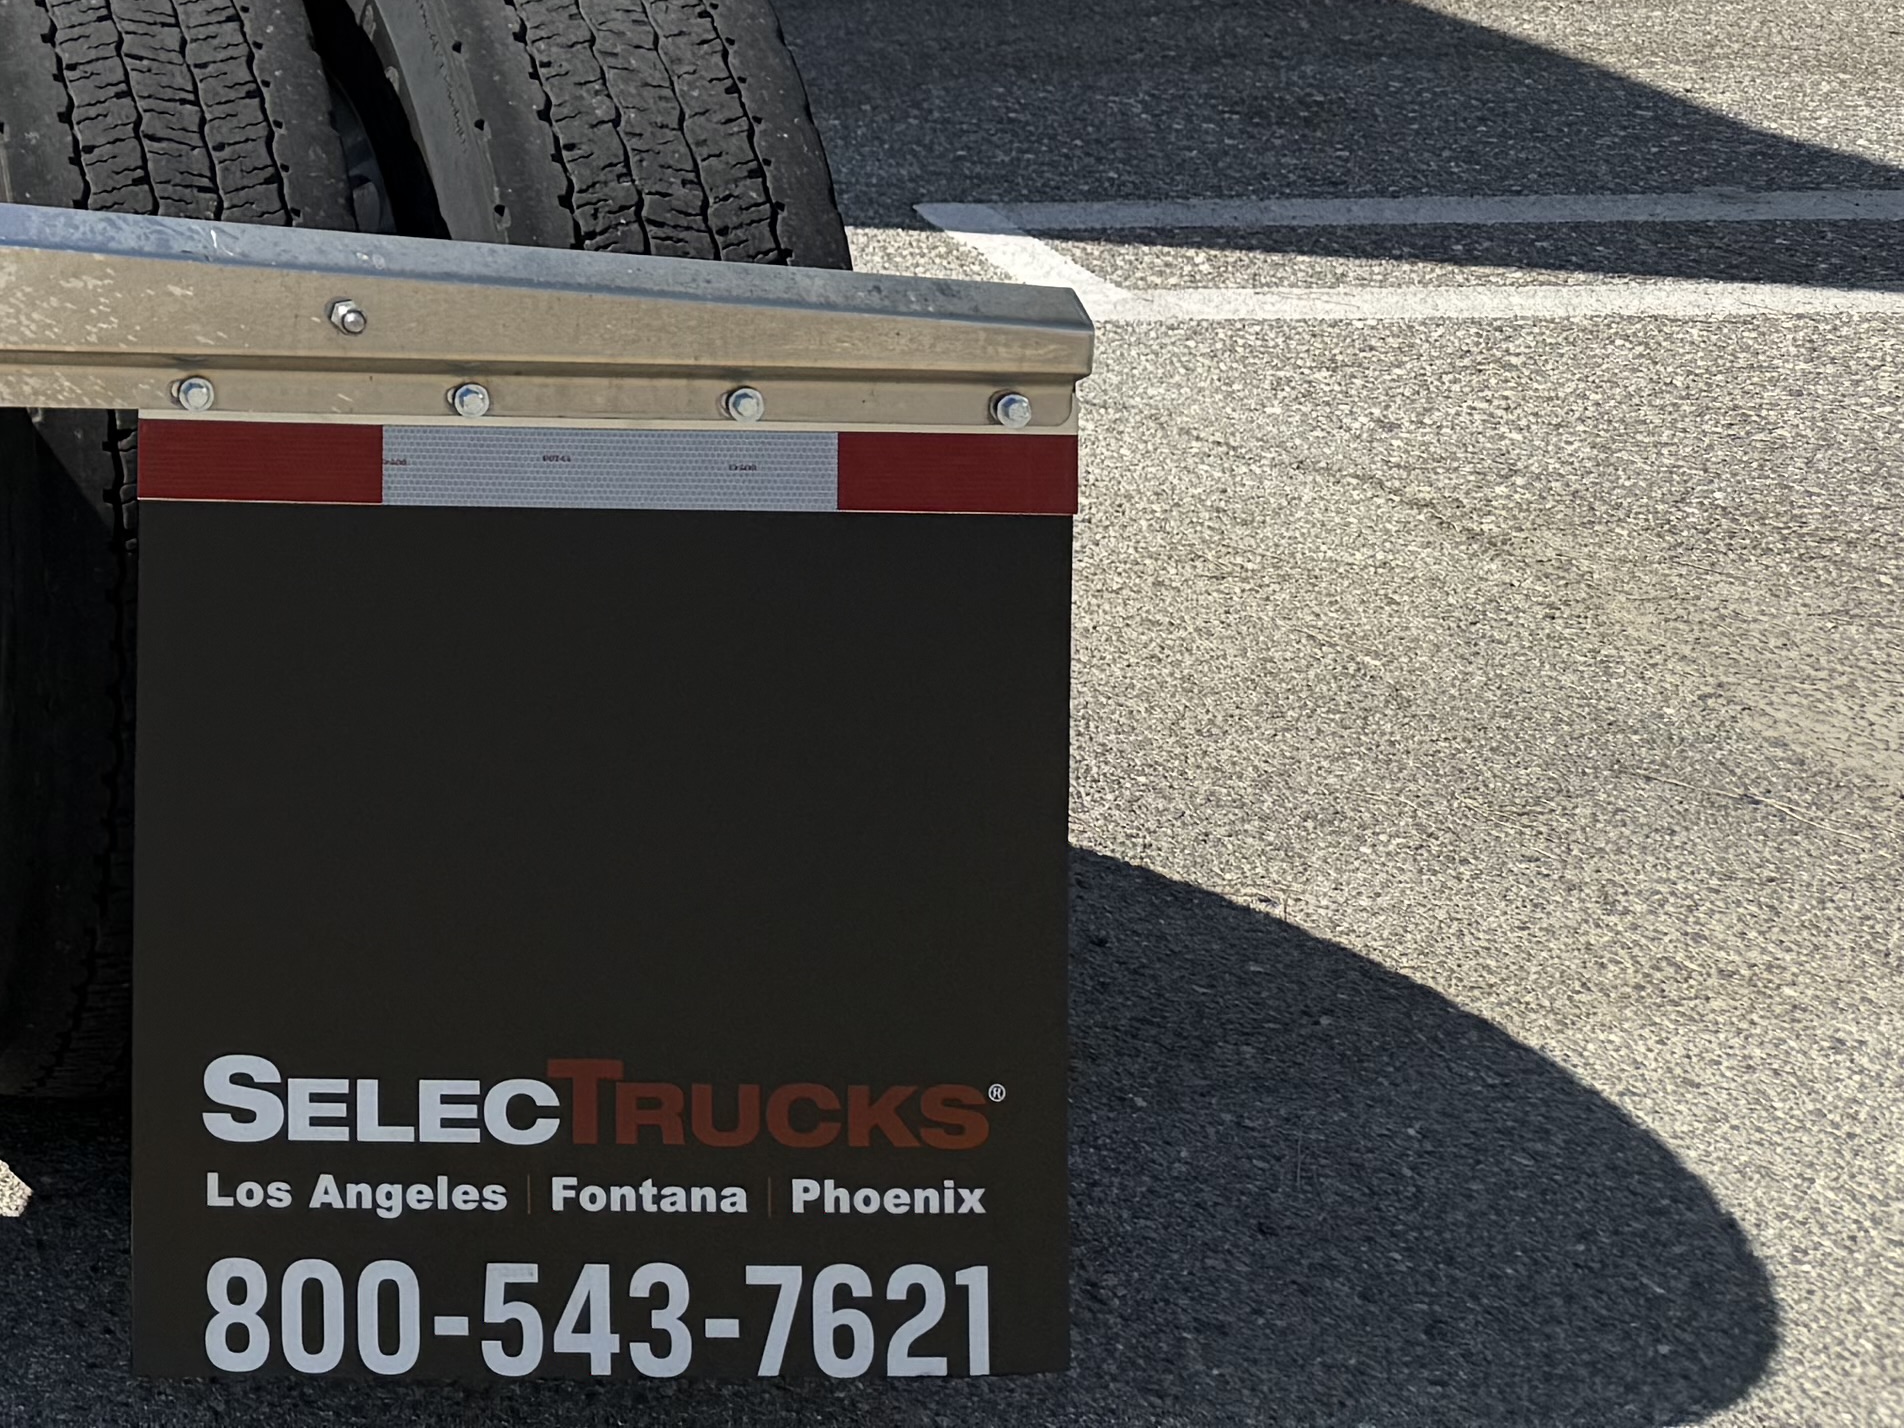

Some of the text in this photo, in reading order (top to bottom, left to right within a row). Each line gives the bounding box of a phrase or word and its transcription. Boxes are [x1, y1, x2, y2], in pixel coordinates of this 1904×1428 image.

[205, 1172, 987, 1220] Los Angeles Fontana Phoenix
[203, 1257, 991, 1379] 800-543-7621
